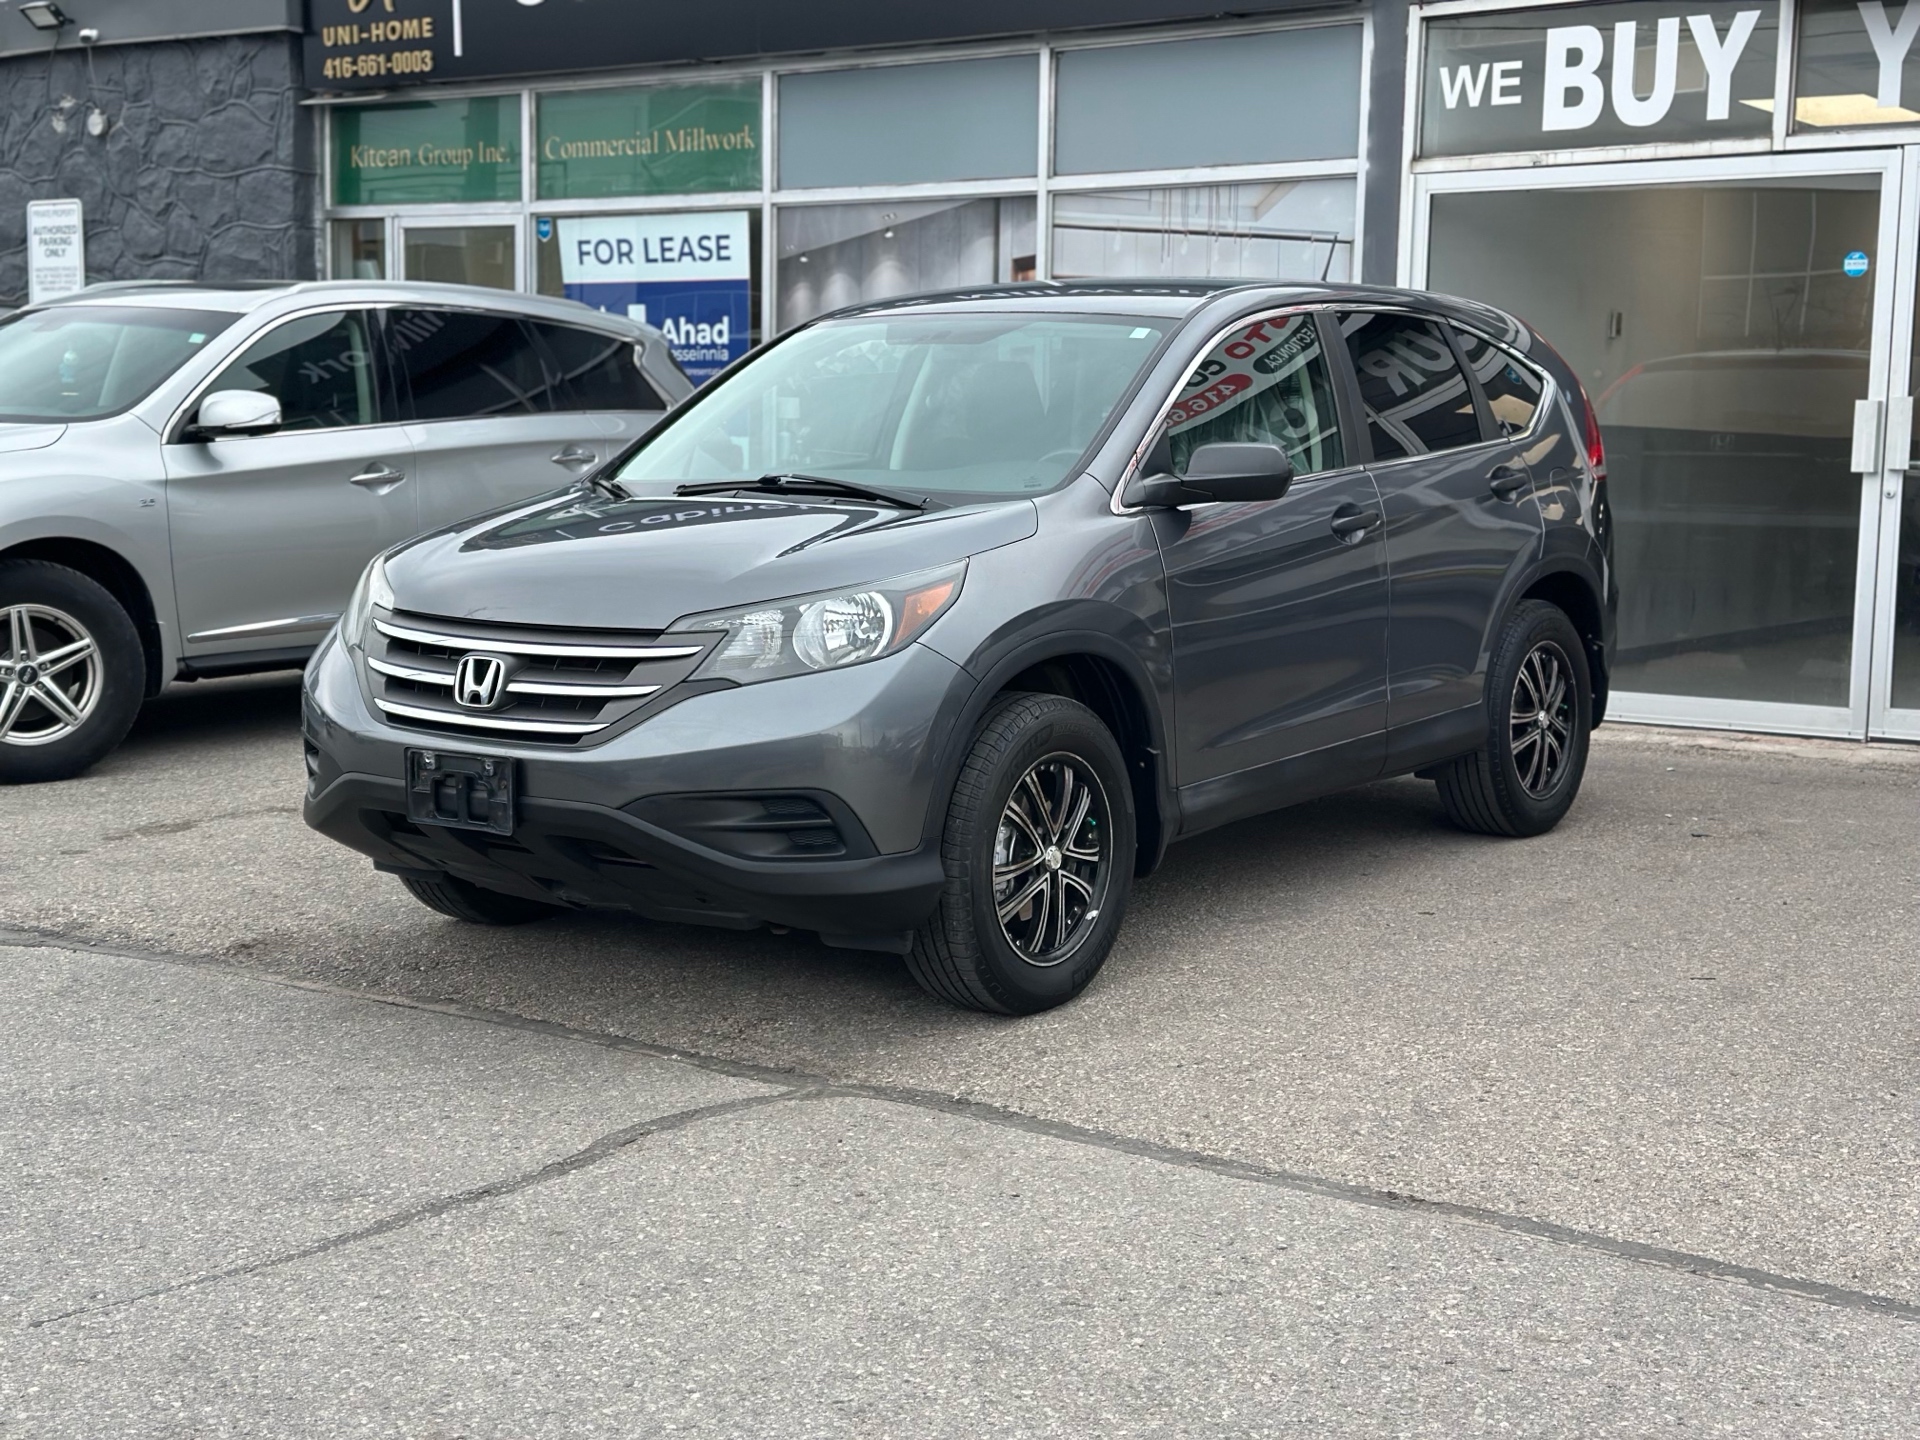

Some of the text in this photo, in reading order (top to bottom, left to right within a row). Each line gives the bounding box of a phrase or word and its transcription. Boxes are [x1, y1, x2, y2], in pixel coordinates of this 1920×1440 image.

[322, 16, 434, 47] UNI-HOME
[322, 49, 433, 79] 416-661-0003
[1857, 0, 1920, 108] Y
[1439, 10, 1762, 132] WE BUY
[351, 141, 511, 171] Kitcan Group Inc.
[544, 125, 755, 160] Commercial Millwork
[33, 225, 77, 236] AUTHORIZED
[39, 236, 72, 246] PARKING
[44, 248, 66, 258] ONLY
[577, 234, 732, 266] FOR LEASE
[663, 315, 729, 345] Ahad
